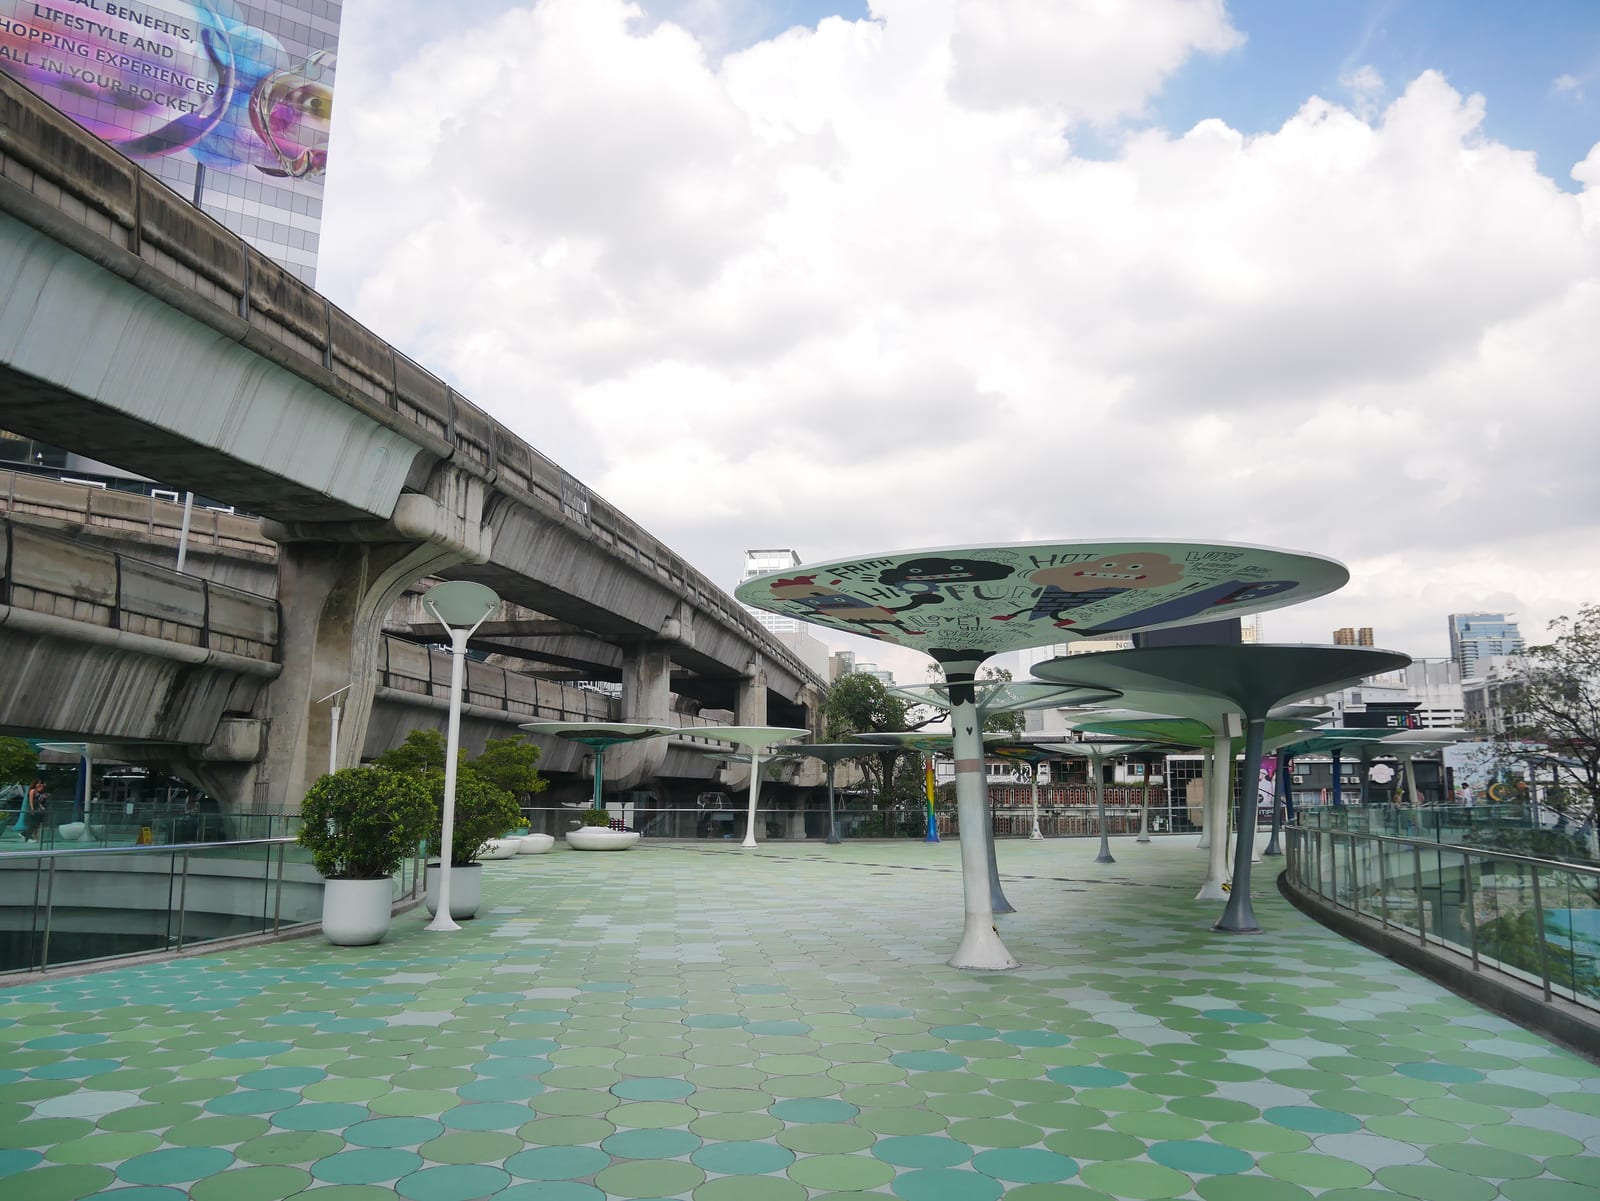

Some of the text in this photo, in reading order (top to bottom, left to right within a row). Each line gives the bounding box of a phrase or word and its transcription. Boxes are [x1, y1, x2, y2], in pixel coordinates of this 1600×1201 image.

[34, 4, 173, 59] LIFESTYLE AND
[105, 3, 194, 43] BENEFITS,
[0, 45, 198, 114] ALL IN YOUR POCKET
[96, 48, 215, 96] EXPERIENCES
[825, 559, 894, 580] FAITH
[1029, 553, 1099, 568] HOT
[854, 587, 901, 601] HI
